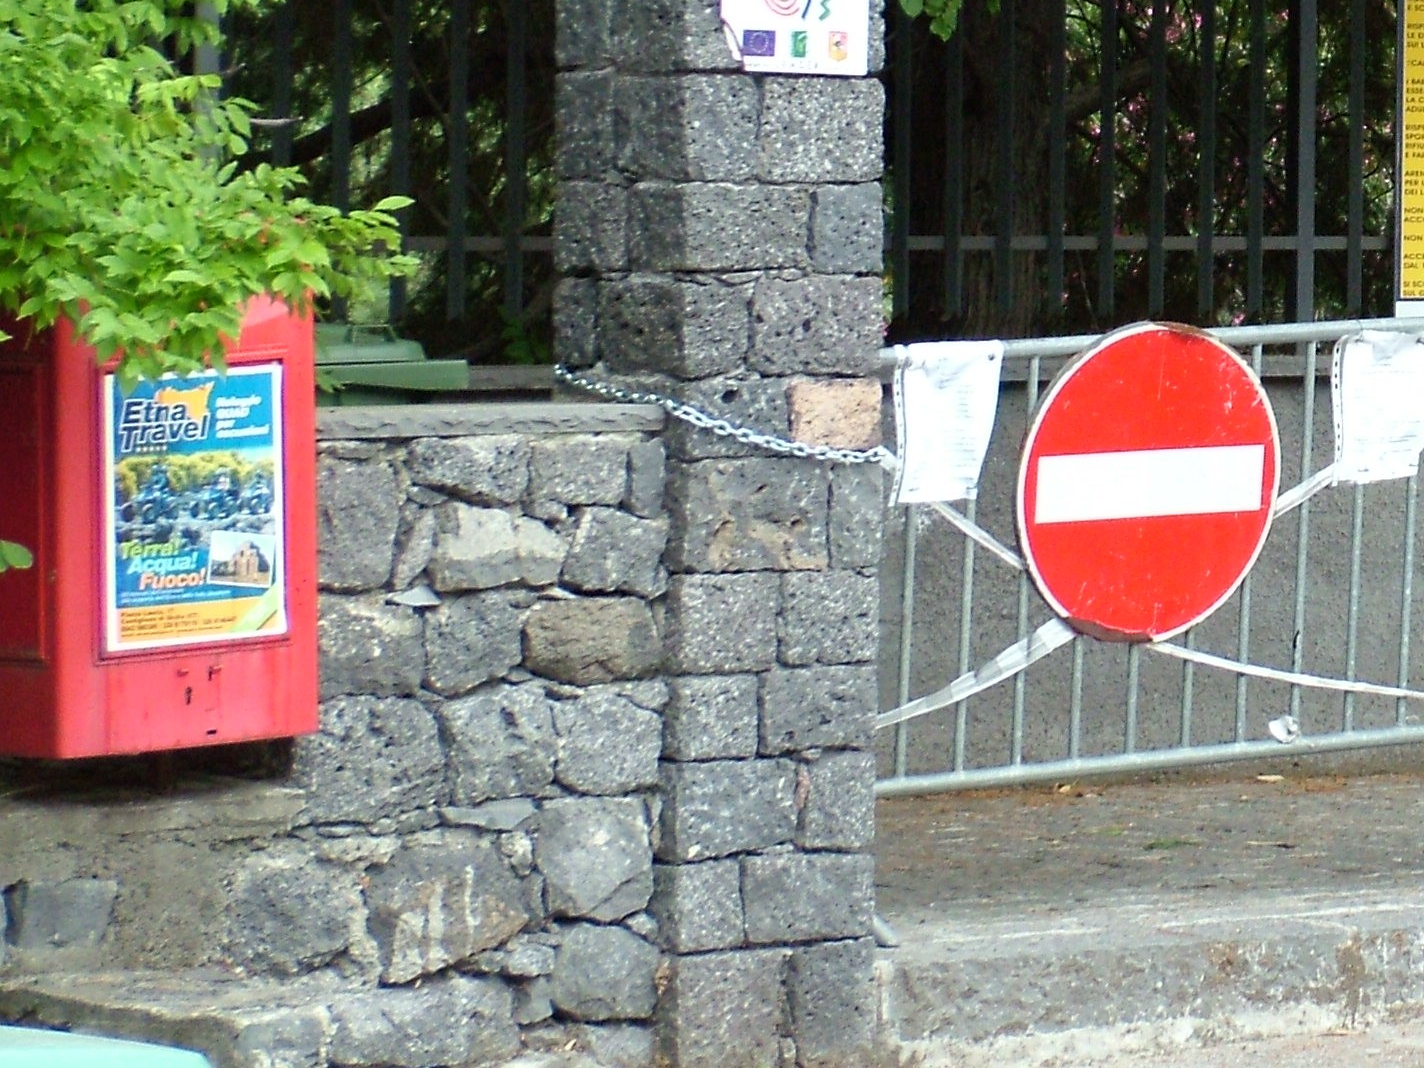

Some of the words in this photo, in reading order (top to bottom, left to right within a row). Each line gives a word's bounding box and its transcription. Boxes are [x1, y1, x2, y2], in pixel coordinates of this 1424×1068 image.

[122, 398, 188, 424] Etna
[120, 413, 211, 452] Travel
[127, 552, 199, 575] Acqua!
[139, 567, 207, 591] Fuoco!
